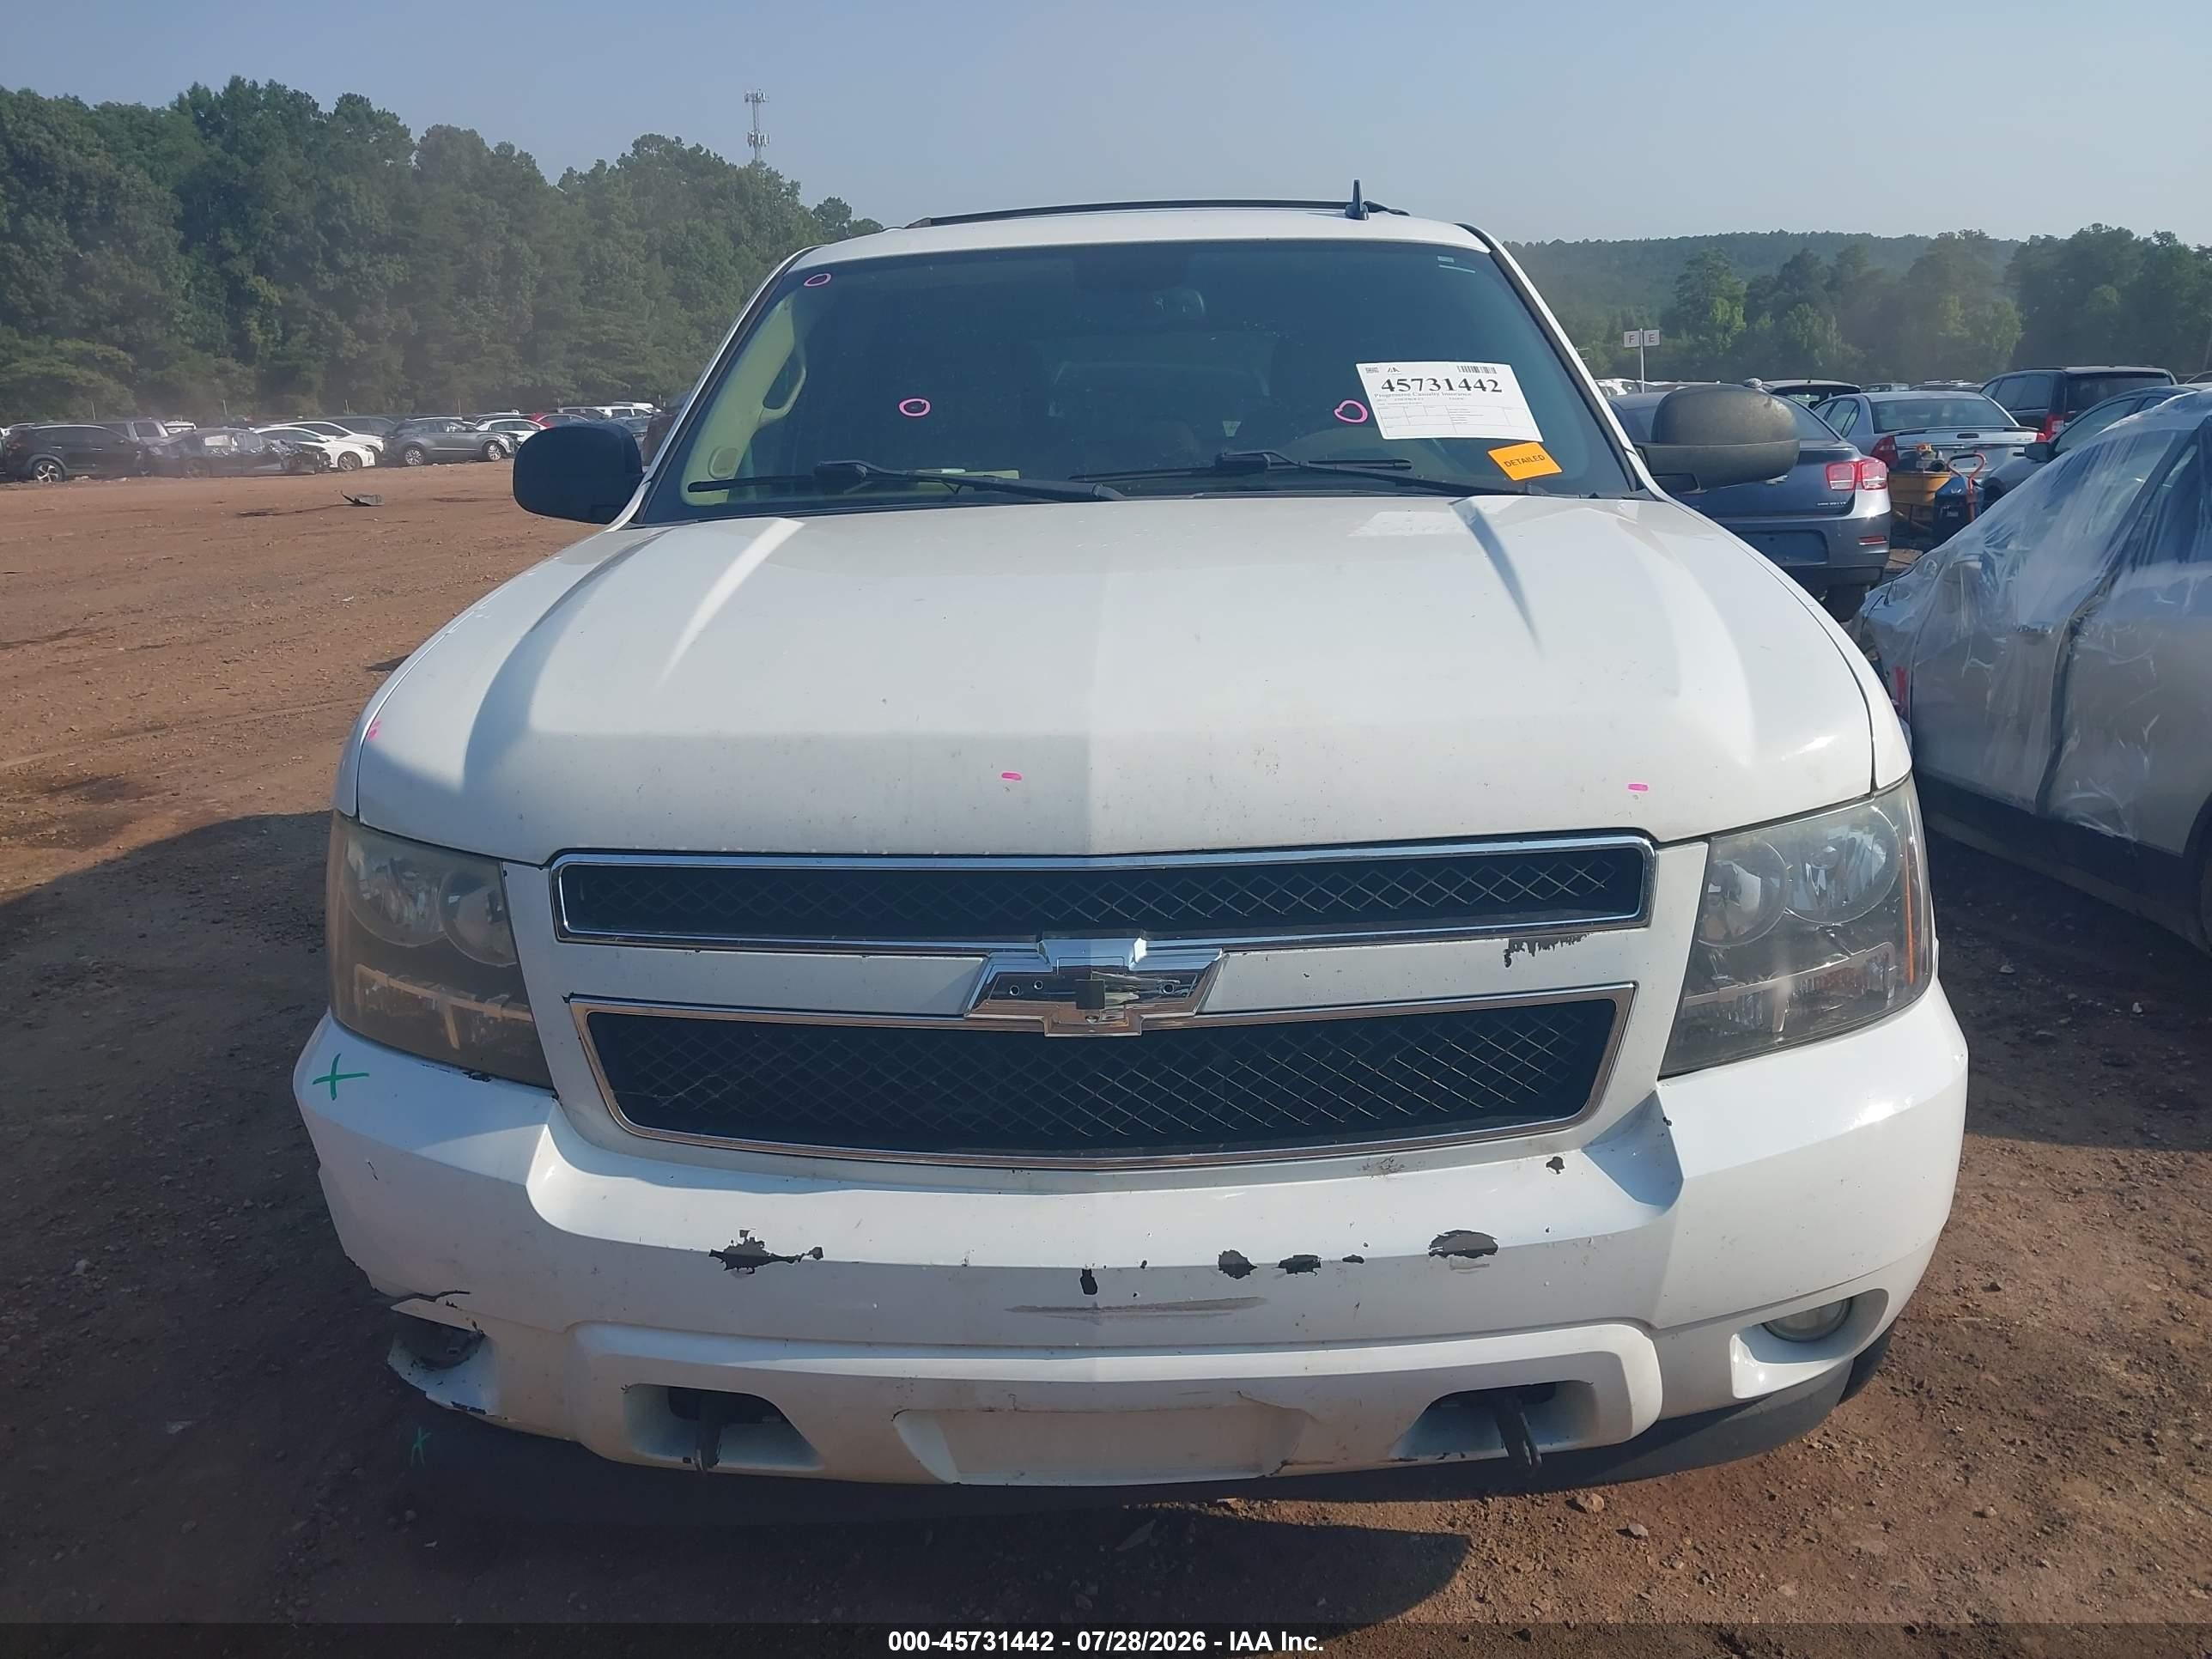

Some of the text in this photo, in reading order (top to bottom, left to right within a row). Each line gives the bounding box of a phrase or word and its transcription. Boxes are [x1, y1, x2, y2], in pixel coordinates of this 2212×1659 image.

[1629, 334, 1636, 343] F
[1649, 333, 1655, 343] E
[1381, 378, 1503, 393] 45731442
[1504, 454, 1547, 468] DETAILED
